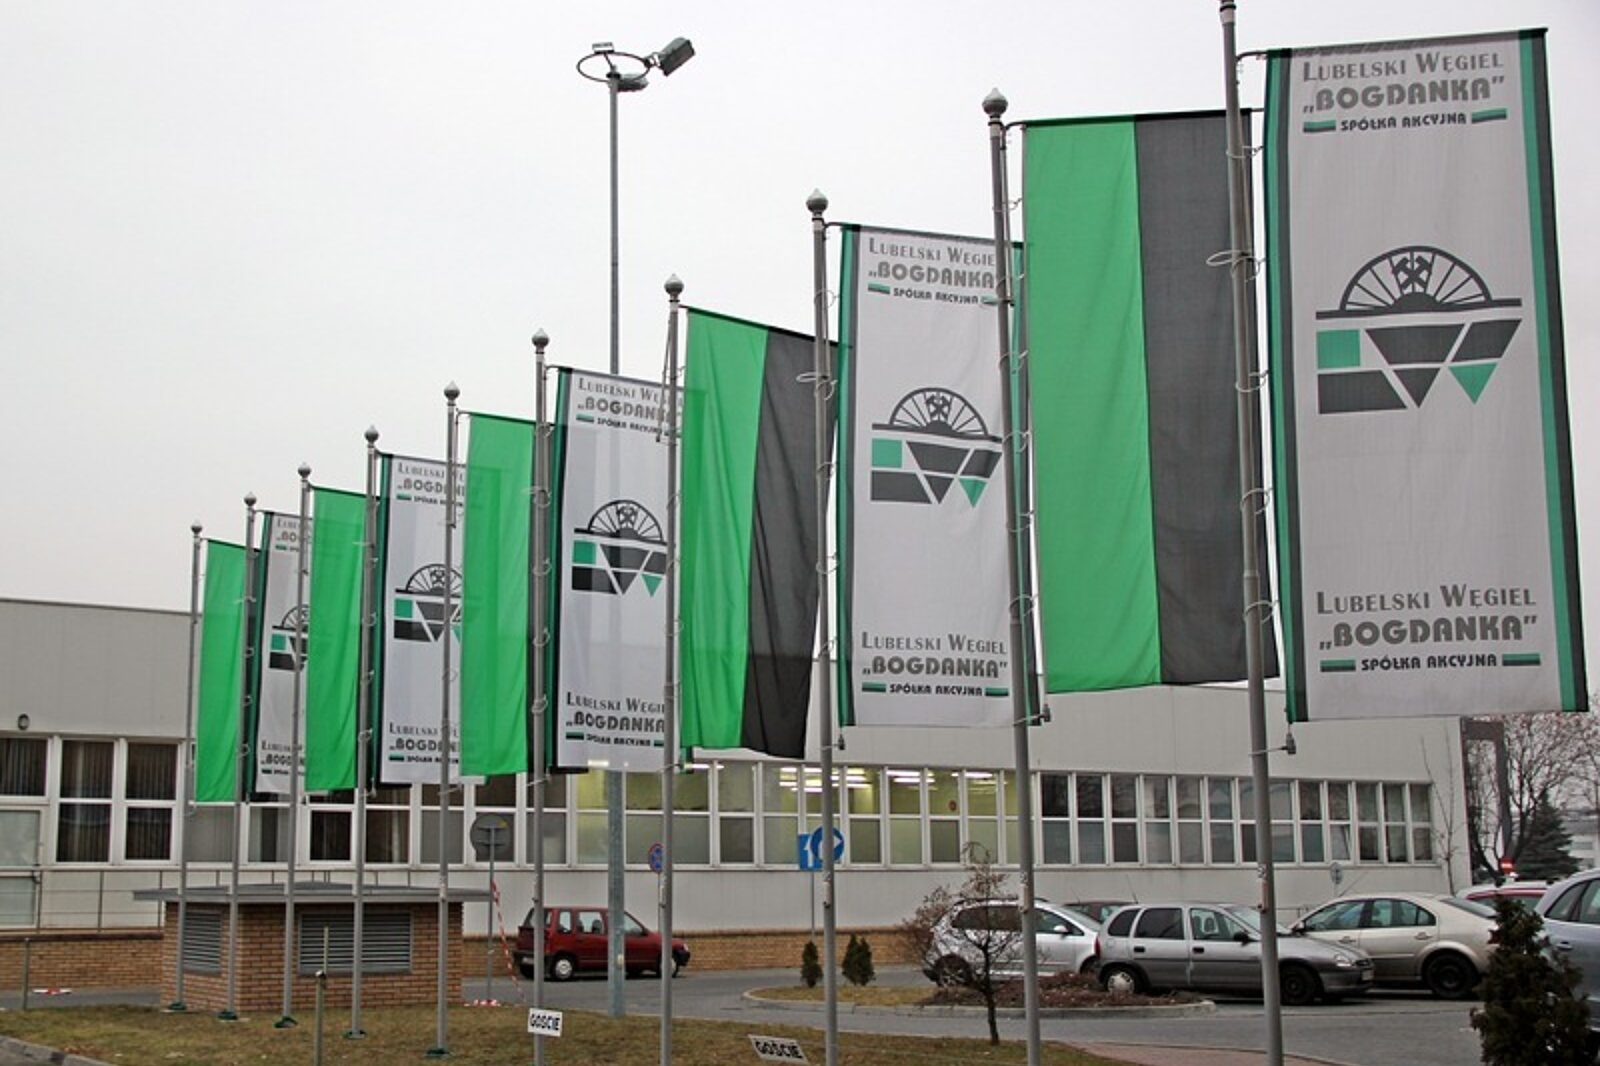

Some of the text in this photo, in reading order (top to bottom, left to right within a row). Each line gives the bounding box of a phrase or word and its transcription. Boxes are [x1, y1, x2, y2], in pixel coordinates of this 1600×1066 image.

[1303, 52, 1504, 82] LUBELSKI WĘGIEL
[1340, 112, 1467, 131] SPÓŁKA AKCYJNA
[869, 237, 995, 266] LUBELSKI WĘGIE
[893, 287, 979, 304] SPÓŁKA AKCYJNA
[1317, 584, 1537, 614] LUBELSKI WĘGIEL
[862, 631, 1008, 654] LUBELSKI WĘGIEL
[1361, 654, 1497, 671] SPÓŁKA AKCYJNA
[889, 682, 982, 696] SPÓŁKA AKCYJNA
